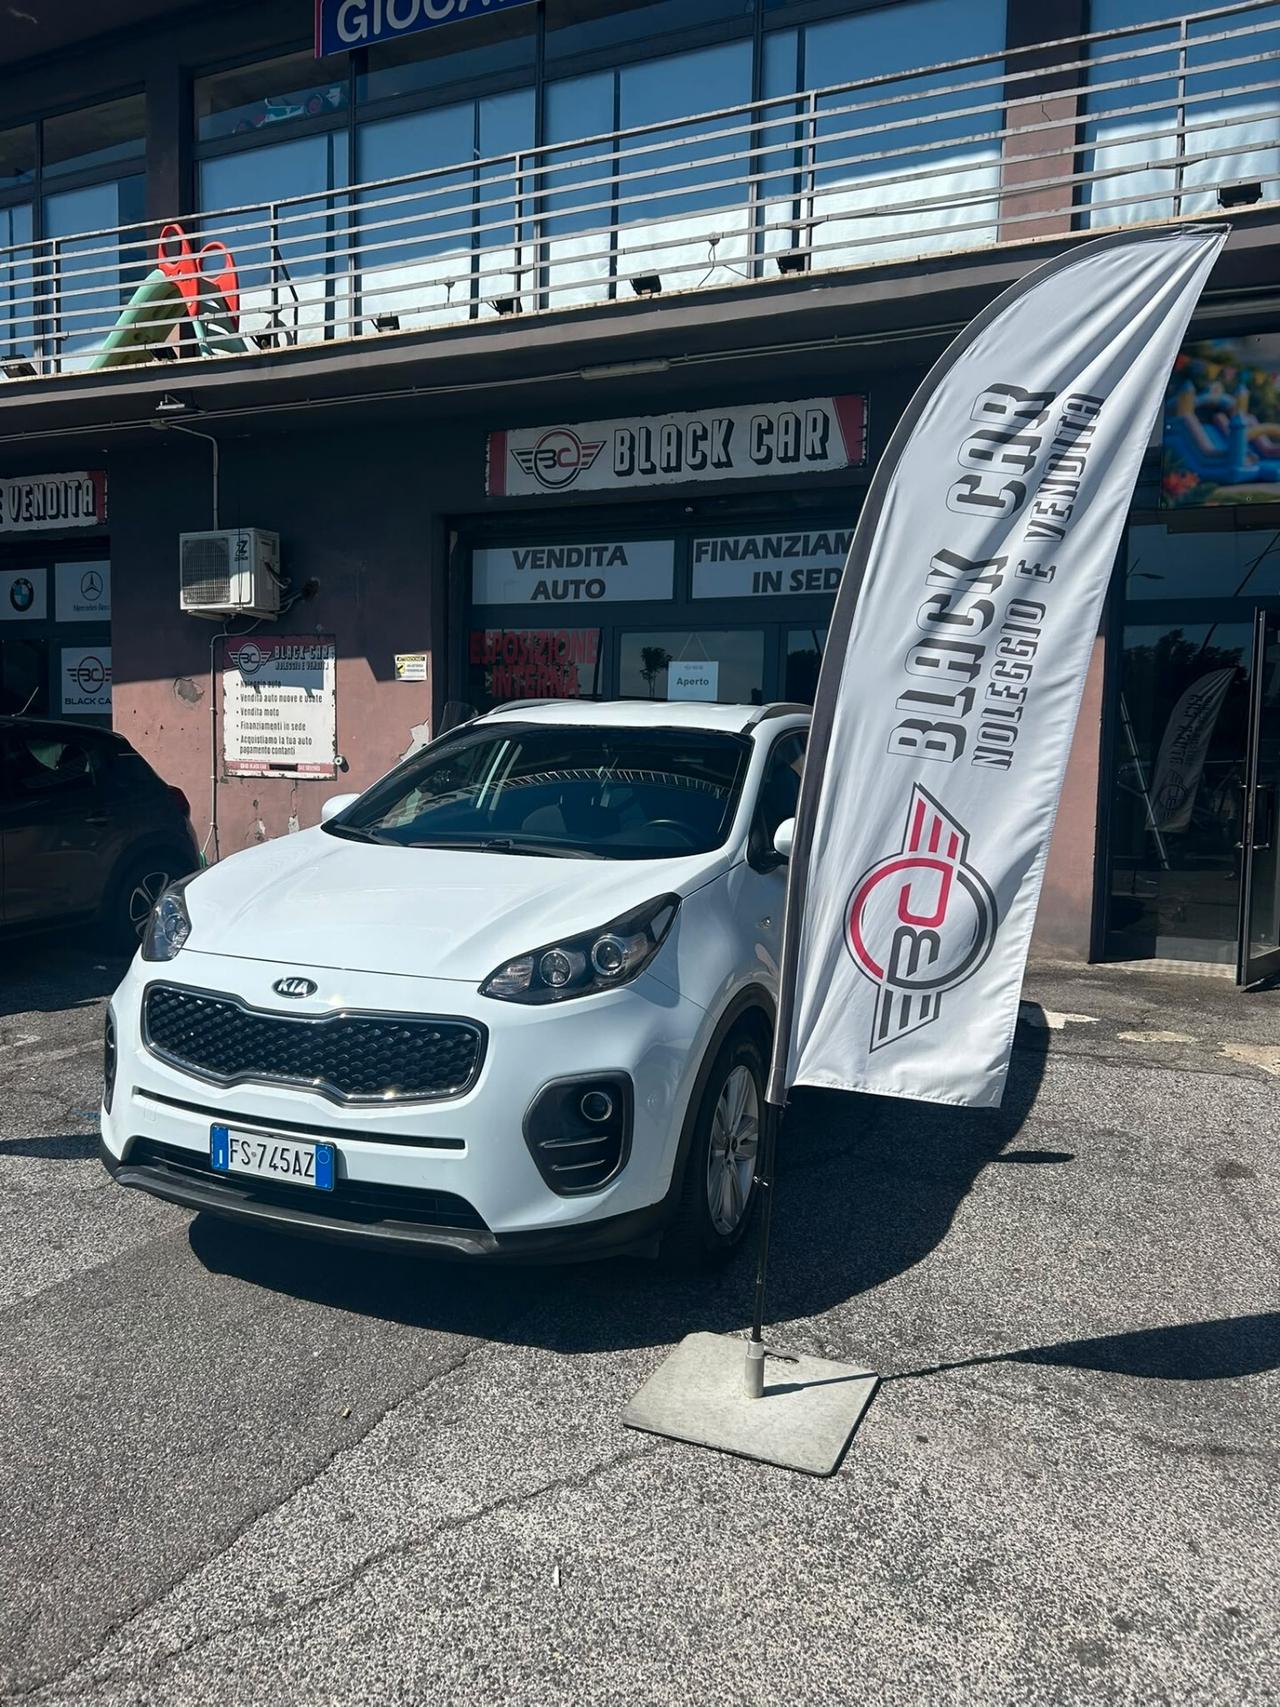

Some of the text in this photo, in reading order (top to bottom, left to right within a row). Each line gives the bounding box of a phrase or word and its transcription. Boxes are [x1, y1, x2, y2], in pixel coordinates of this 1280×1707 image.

[613, 418, 734, 477] BLACK
[750, 408, 829, 464] CAR
[9, 478, 97, 522] VENDITA
[512, 545, 628, 570] VENDITA
[695, 531, 855, 563] FINANZIAM
[752, 567, 843, 593] IN SED
[886, 382, 1056, 763] BLACK CAR
[970, 392, 1105, 771] NOLEGGIO E VENDITA
[530, 578, 606, 601] AUTO
[274, 645, 305, 660] BLACK
[309, 645, 329, 660] CAR
[491, 663, 581, 698] INTERNA
[676, 677, 709, 686] Aperto
[240, 693, 263, 703] Vendita
[264, 694, 278, 703] auto
[279, 694, 298, 703] nuove
[304, 694, 323, 704] usate
[240, 707, 280, 717] Vendita moto
[240, 721, 306, 731] Finanziamenti in sede
[239, 745, 296, 756] pagamento contanti
[240, 735, 313, 746] Acquistiamo la tua auto
[277, 977, 309, 993] KIA
